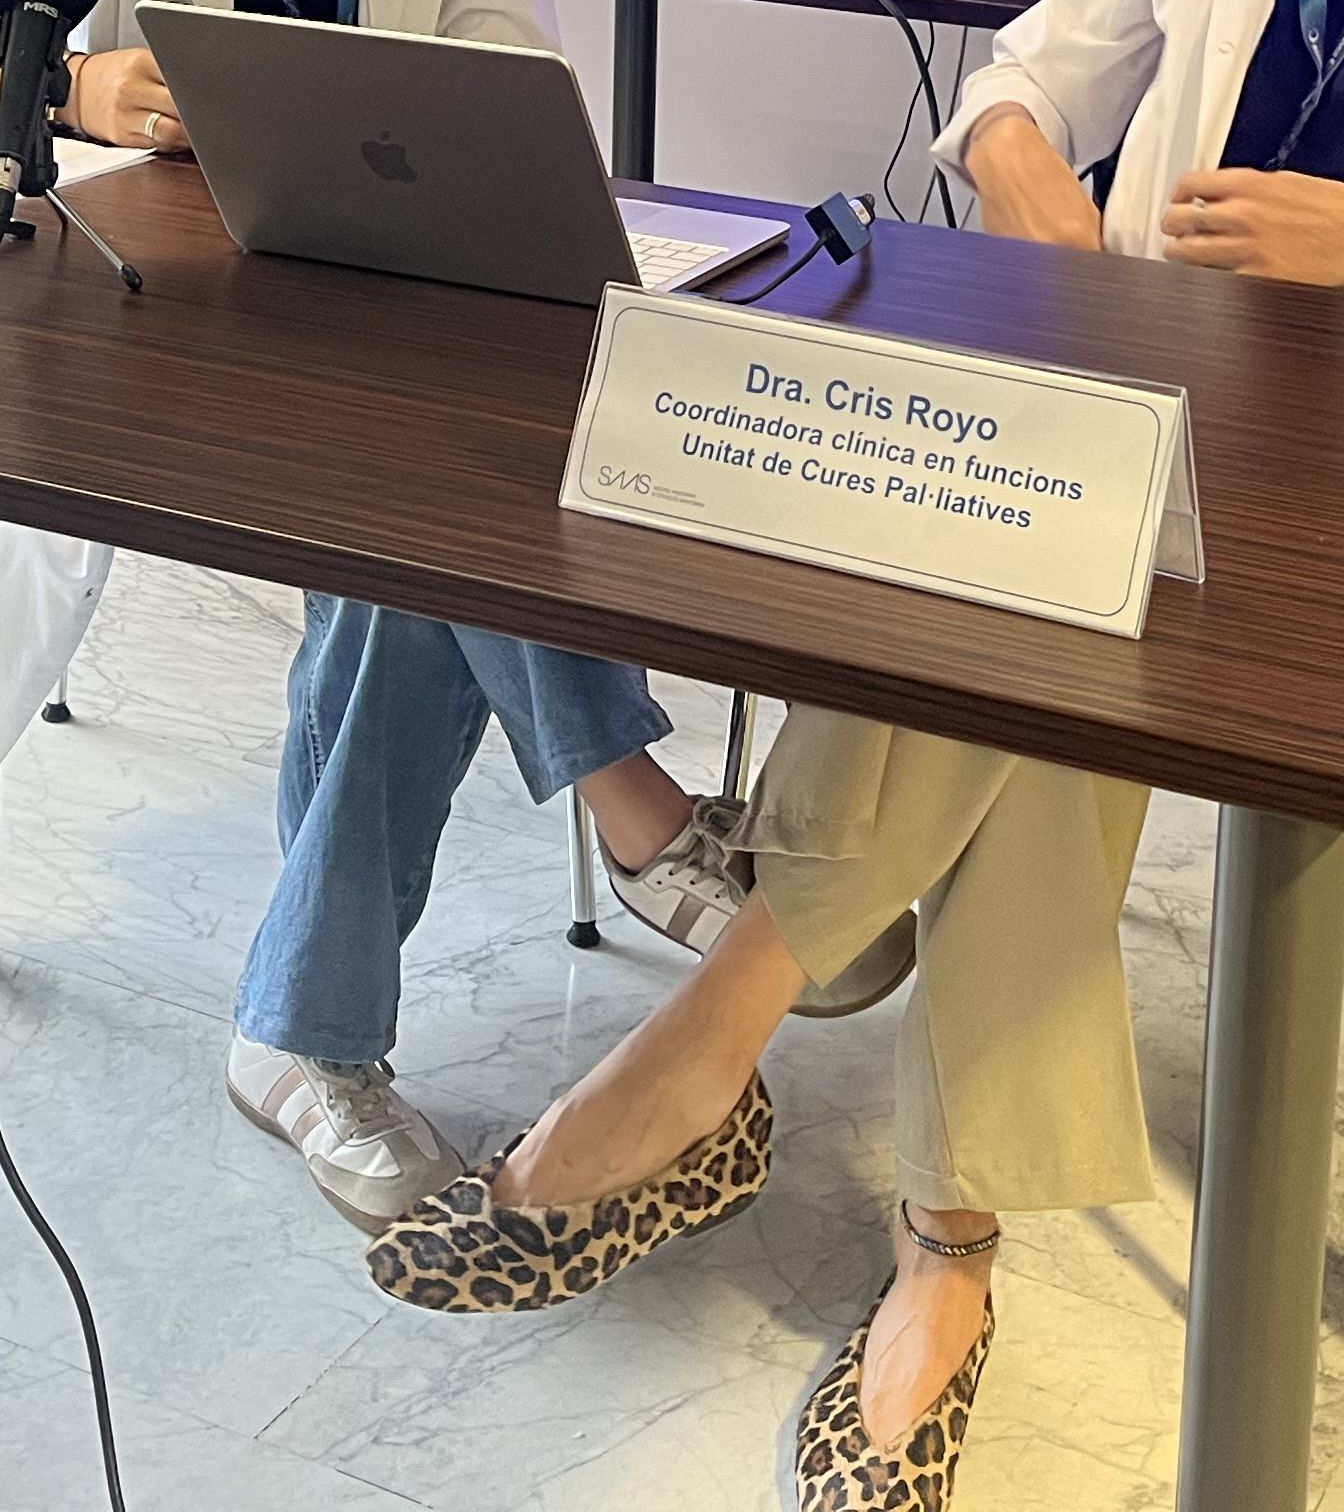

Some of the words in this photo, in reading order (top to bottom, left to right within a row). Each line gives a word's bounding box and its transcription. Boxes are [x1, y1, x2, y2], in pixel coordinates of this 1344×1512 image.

[654, 391, 824, 446] Coordinadora
[831, 429, 917, 466] clínica
[923, 451, 956, 474] en
[964, 454, 1084, 501] funcions
[745, 362, 811, 405] Dra.
[825, 379, 893, 420] Cris
[905, 393, 999, 444] Royo
[682, 432, 756, 469] Unitat
[761, 451, 792, 476] de
[800, 458, 877, 495] Cures
[884, 475, 1032, 529] Pal·liatives
